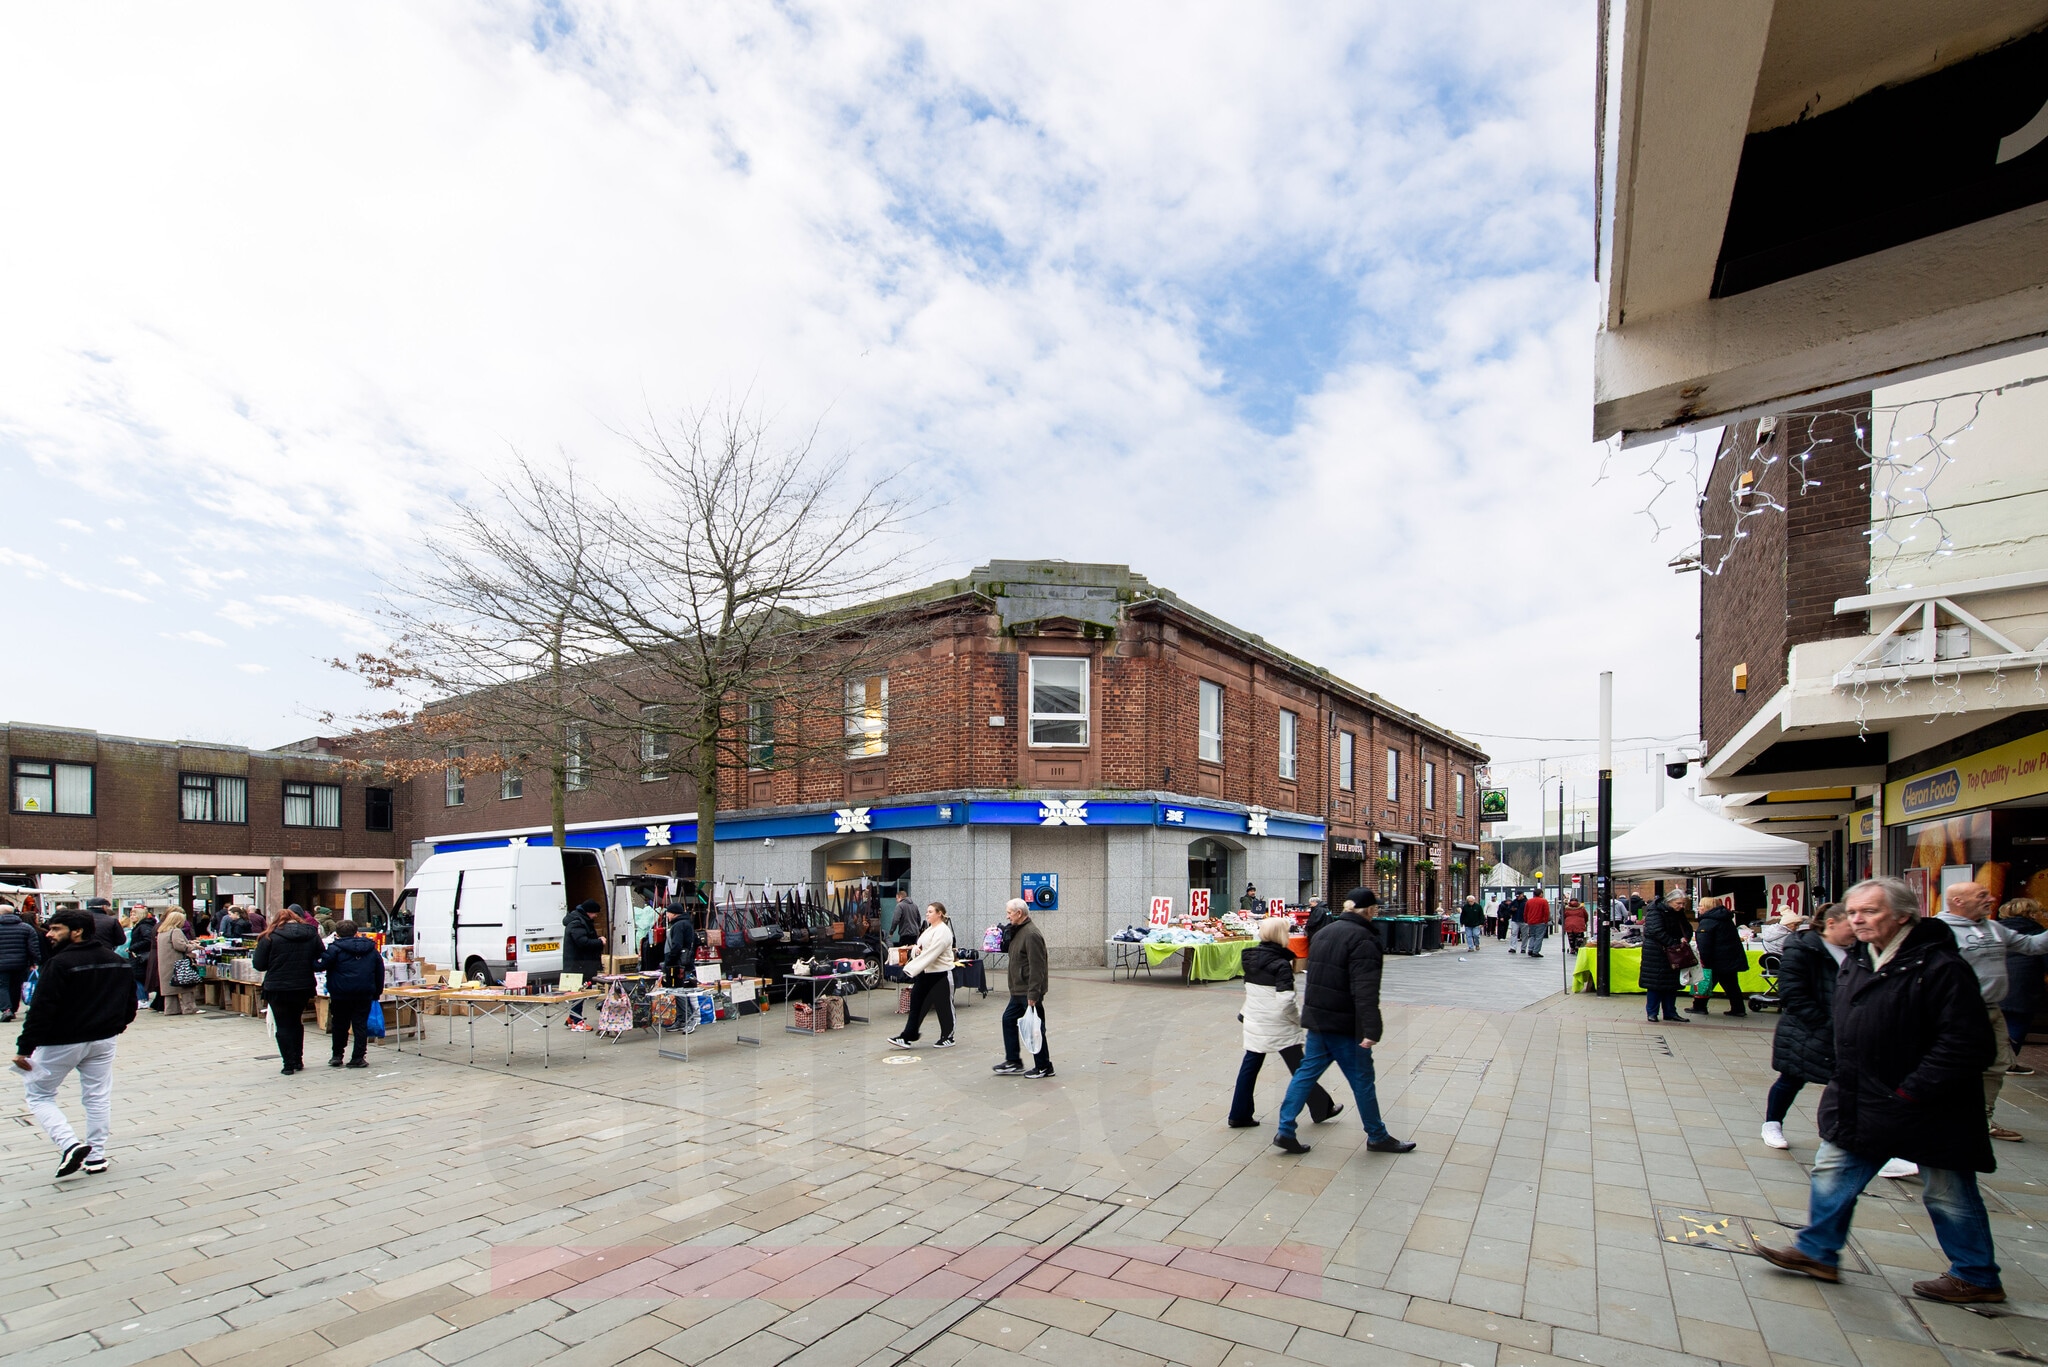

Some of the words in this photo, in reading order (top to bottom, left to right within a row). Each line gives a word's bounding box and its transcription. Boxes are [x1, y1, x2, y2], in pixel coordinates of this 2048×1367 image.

[1967, 773, 1980, 792] Top
[1981, 764, 2010, 790] Quality
[2018, 758, 2038, 776] Low
[1904, 787, 1929, 808] Heron
[1929, 774, 1957, 801] Foods
[1335, 843, 1347, 852] FREE
[1152, 898, 1170, 925] £5
[1192, 890, 1209, 916] £5
[1270, 899, 1283, 917] £5
[1771, 884, 1799, 917] £8
